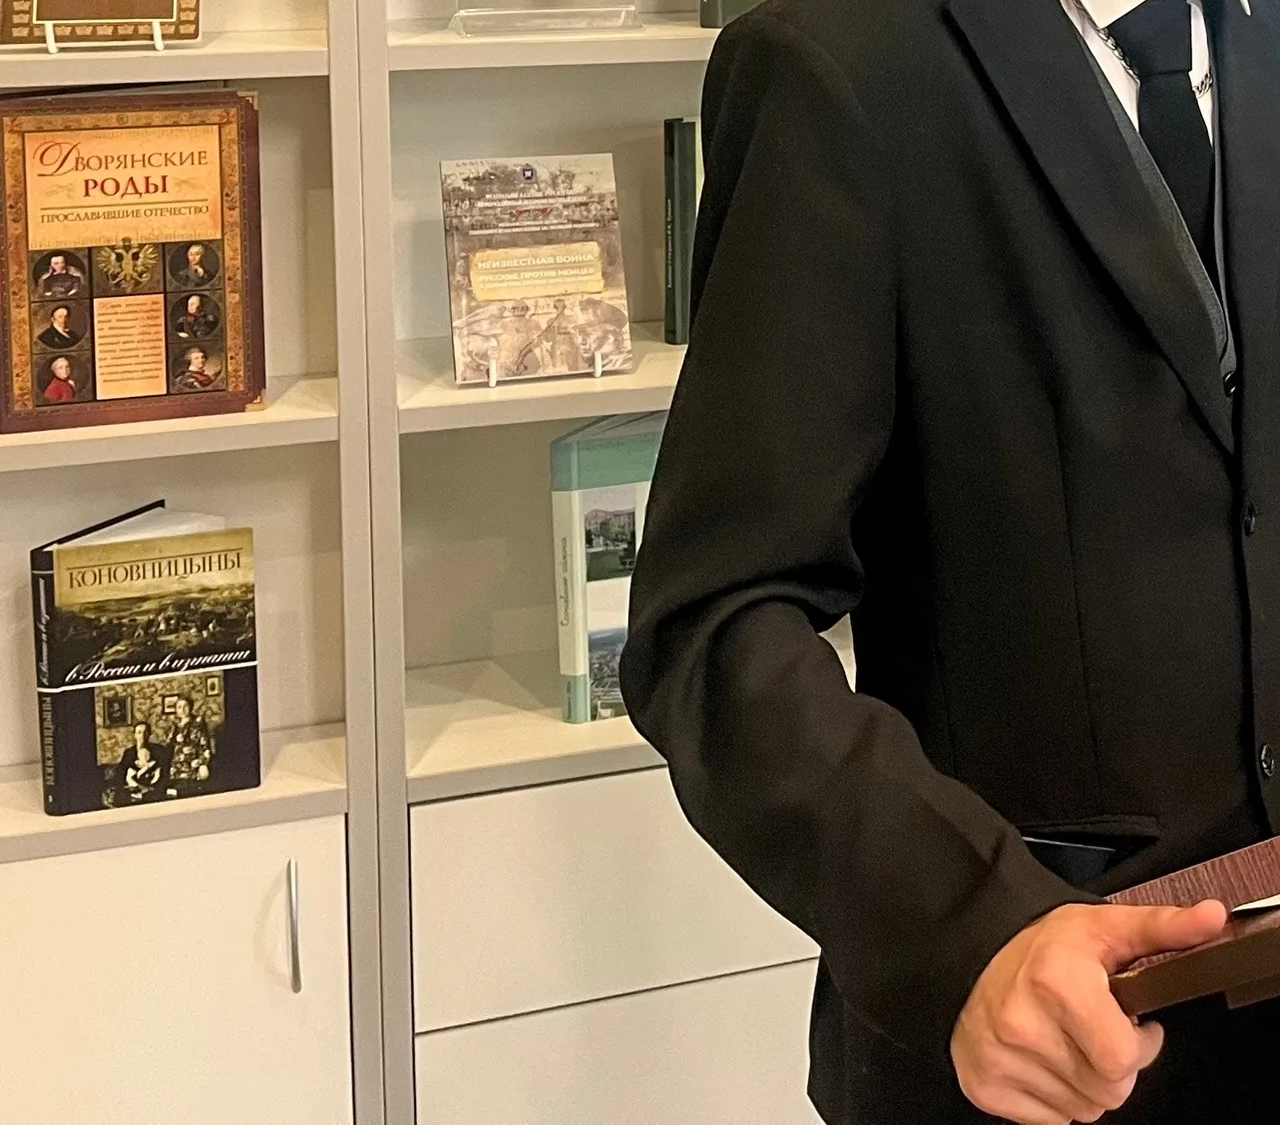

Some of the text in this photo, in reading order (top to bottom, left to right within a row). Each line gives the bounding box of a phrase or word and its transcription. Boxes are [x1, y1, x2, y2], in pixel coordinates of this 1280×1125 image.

[33, 140, 208, 177] ДВОРЯНСКИЕ
[83, 175, 169, 199] РОДЫ
[40, 205, 209, 224] ПРОСЛАВИВШИЕ ОТЕЧЕСТВО
[556, 254, 594, 264] ВОЙНА
[69, 551, 241, 589] КОНОВНИЦЫНЫ
[79, 661, 141, 681] России
